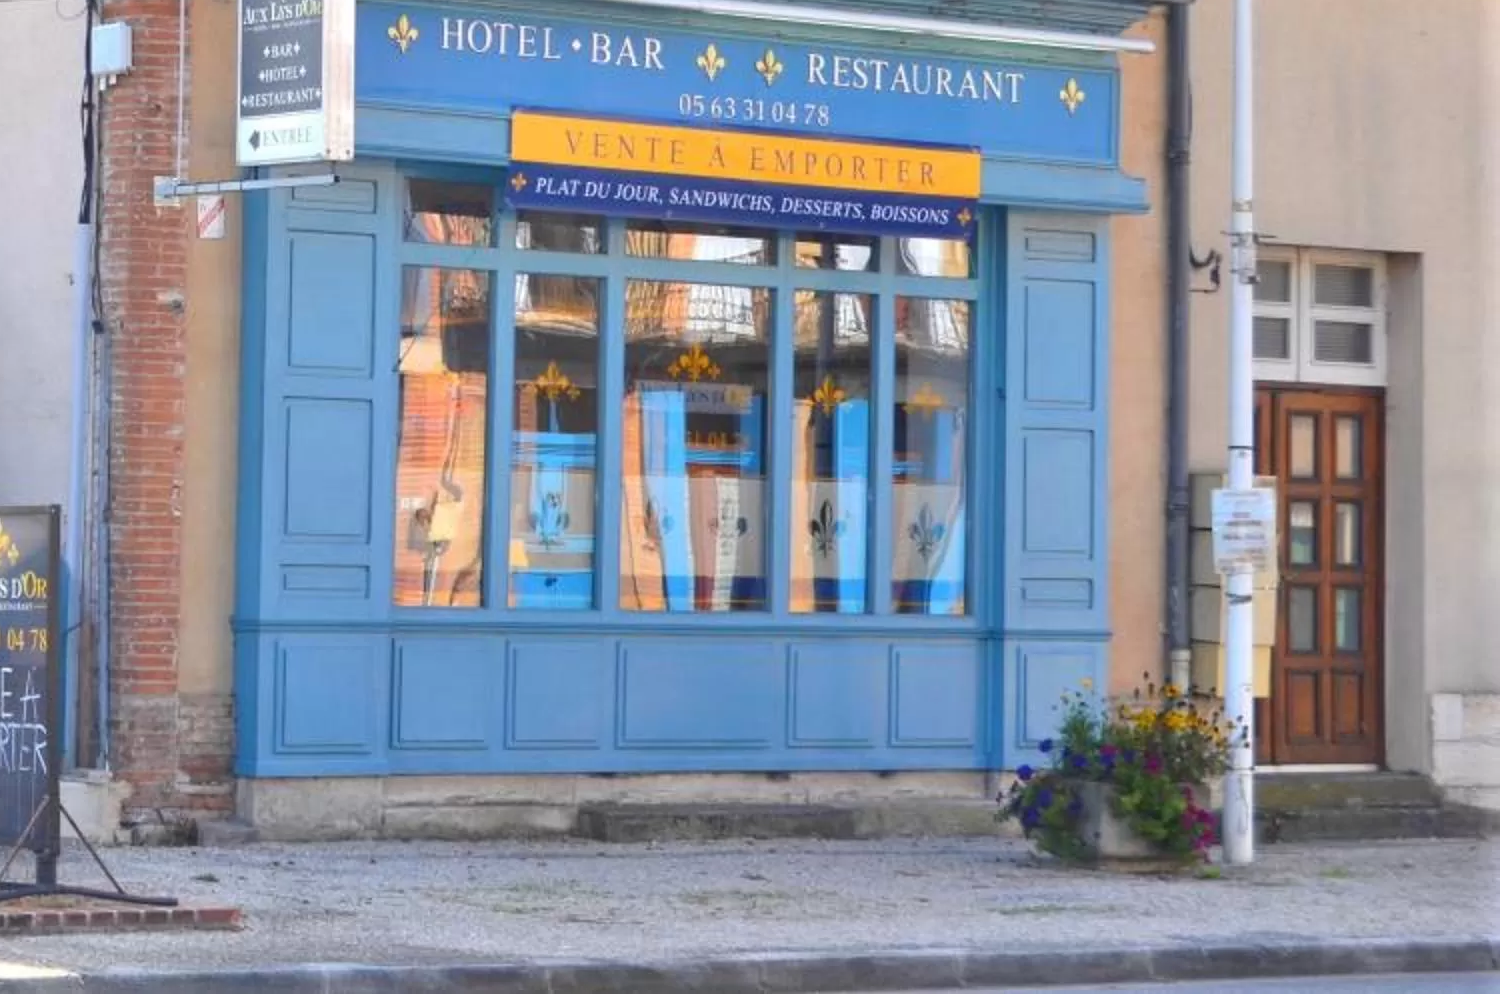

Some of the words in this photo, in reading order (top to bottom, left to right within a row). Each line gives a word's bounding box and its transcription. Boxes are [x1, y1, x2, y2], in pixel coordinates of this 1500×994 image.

[271, 43, 293, 59] BAR
[441, 18, 562, 59] HOTEL
[592, 32, 665, 70] BAR
[249, 88, 314, 107] RESTAURANT
[808, 53, 1025, 105] RESTAURANT
[679, 94, 705, 117] 05
[711, 98, 736, 119] 63
[744, 101, 764, 121] 31
[772, 102, 797, 124] 04
[805, 104, 830, 127] 78
[565, 130, 685, 165] VENTE
[751, 147, 935, 187] EMPORTER
[536, 178, 581, 197] PLAT
[585, 182, 611, 199] DU
[613, 184, 663, 205] JOUR,
[670, 187, 775, 214] SANDWICHS,
[780, 198, 865, 221] DESSERTS,
[871, 206, 950, 226] BOISSONS
[8, 627, 25, 651] 04
[29, 629, 48, 654] 78
